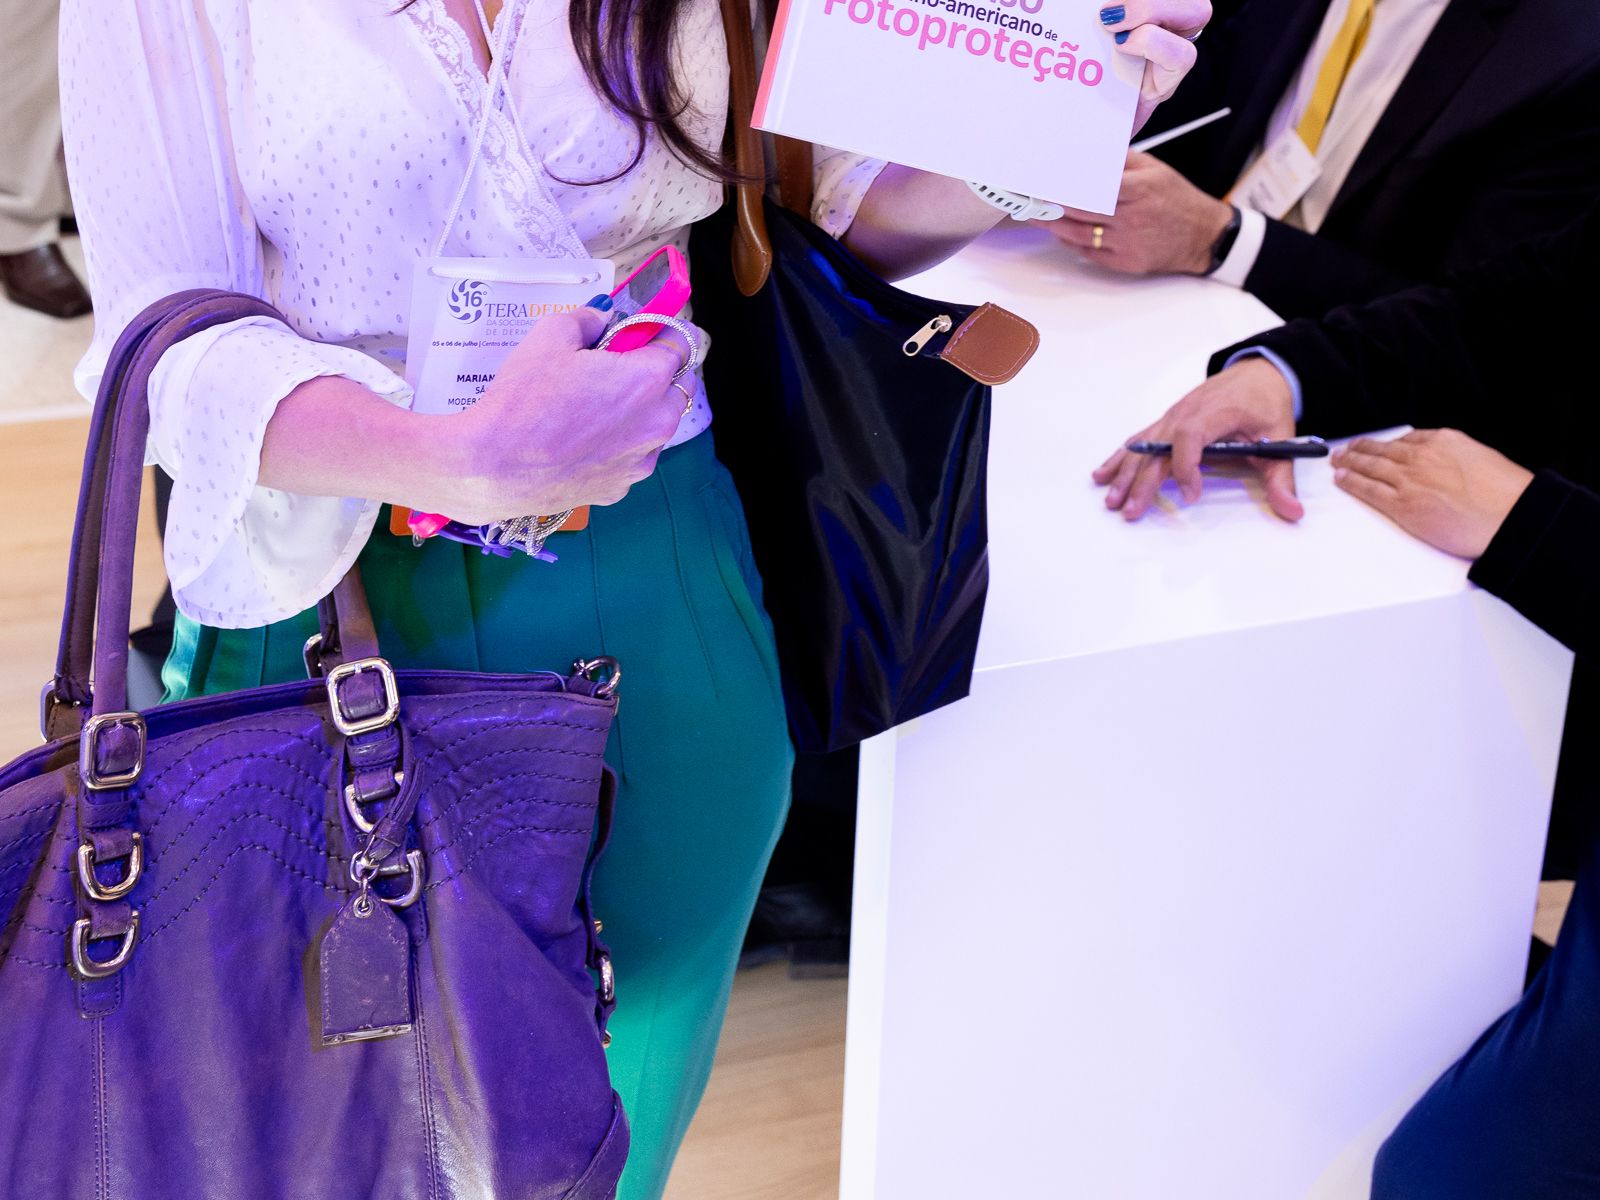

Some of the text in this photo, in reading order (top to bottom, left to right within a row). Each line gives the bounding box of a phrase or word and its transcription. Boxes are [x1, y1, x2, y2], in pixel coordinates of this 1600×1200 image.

[1044, 28, 1058, 42] de
[486, 319, 536, 327] DA SOCIEDAD
[486, 328, 528, 336] DE DERM
[456, 374, 496, 383] MARIAN
